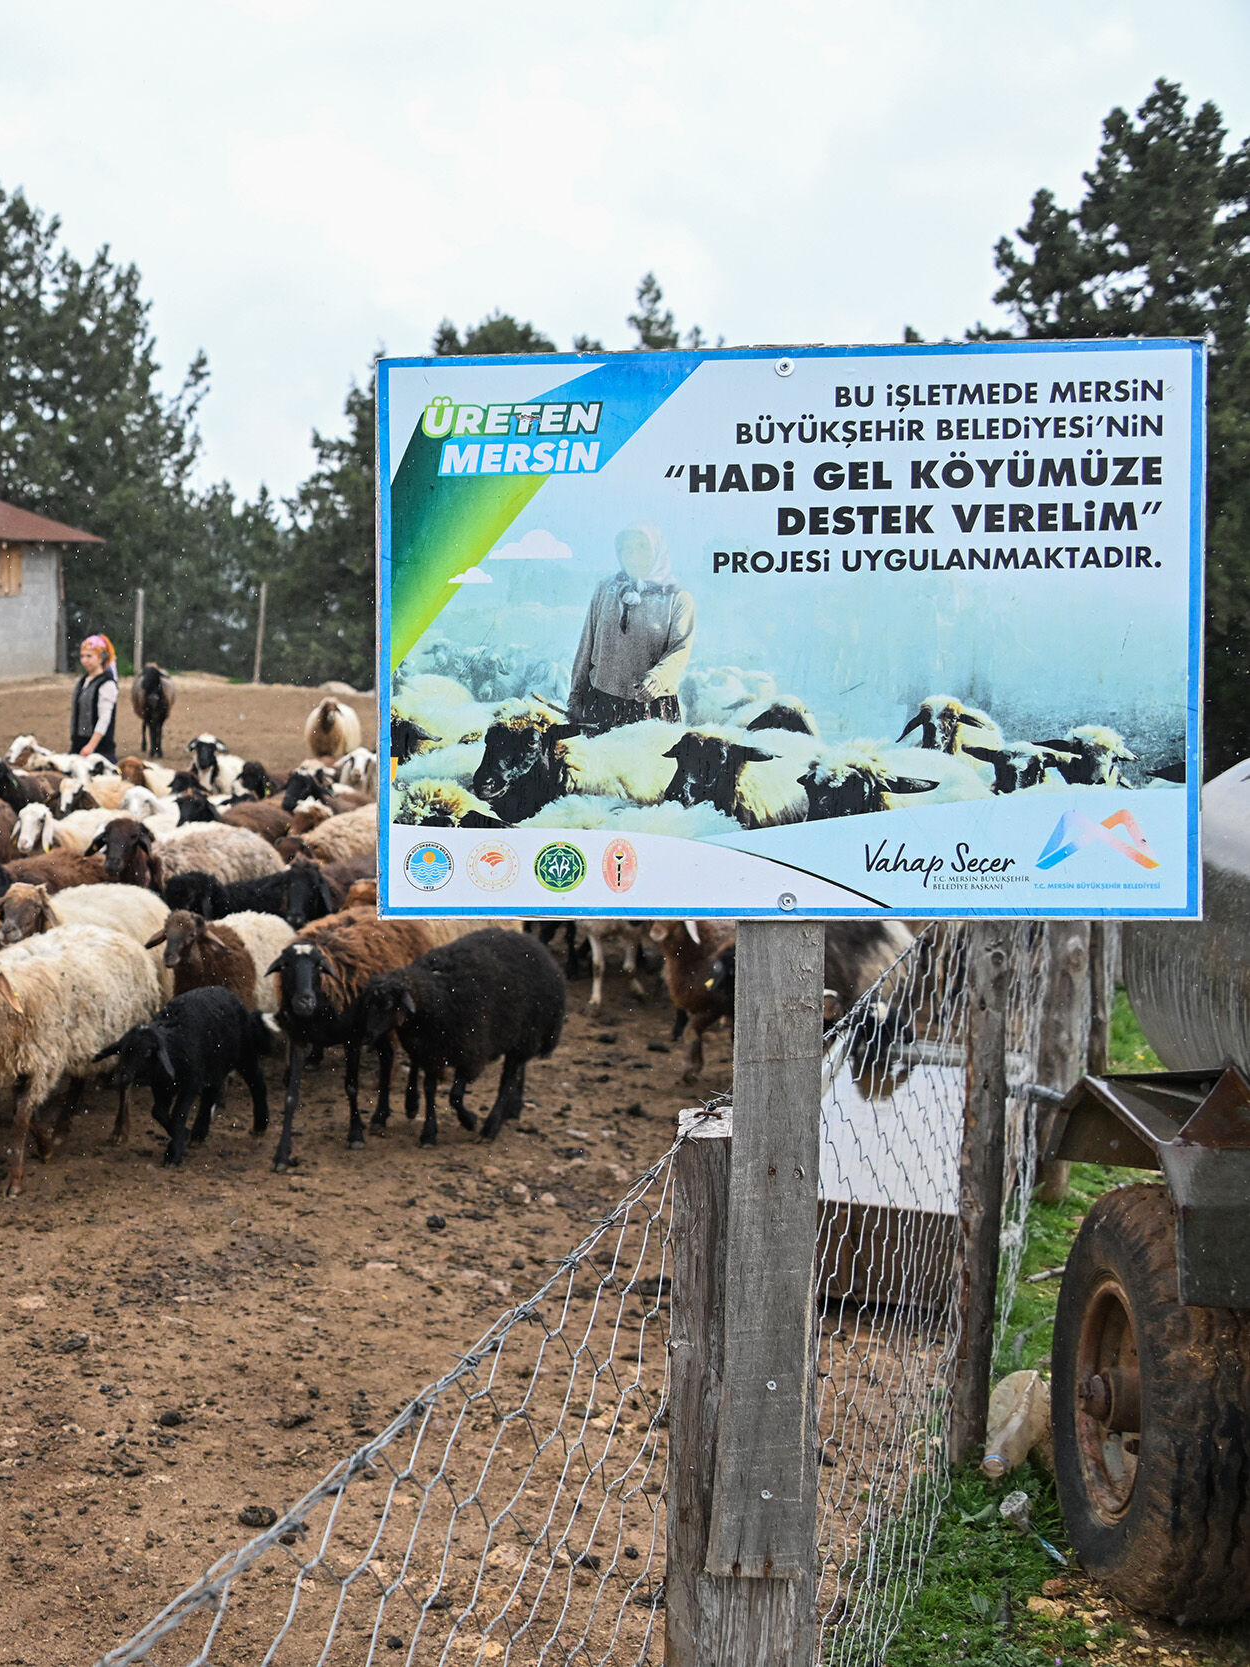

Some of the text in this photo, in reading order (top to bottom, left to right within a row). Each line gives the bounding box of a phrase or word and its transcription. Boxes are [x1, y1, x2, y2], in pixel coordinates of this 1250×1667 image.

[835, 385, 874, 408] BU
[423, 397, 602, 437] ÜRETEN
[813, 461, 893, 491] GEL
[910, 455, 1162, 490] KÖYÜMÜZE
[777, 504, 935, 536] DESTEK
[842, 546, 1162, 573] UYGULANMAKTADIR.
[865, 839, 1016, 889] Vahap Seçer
